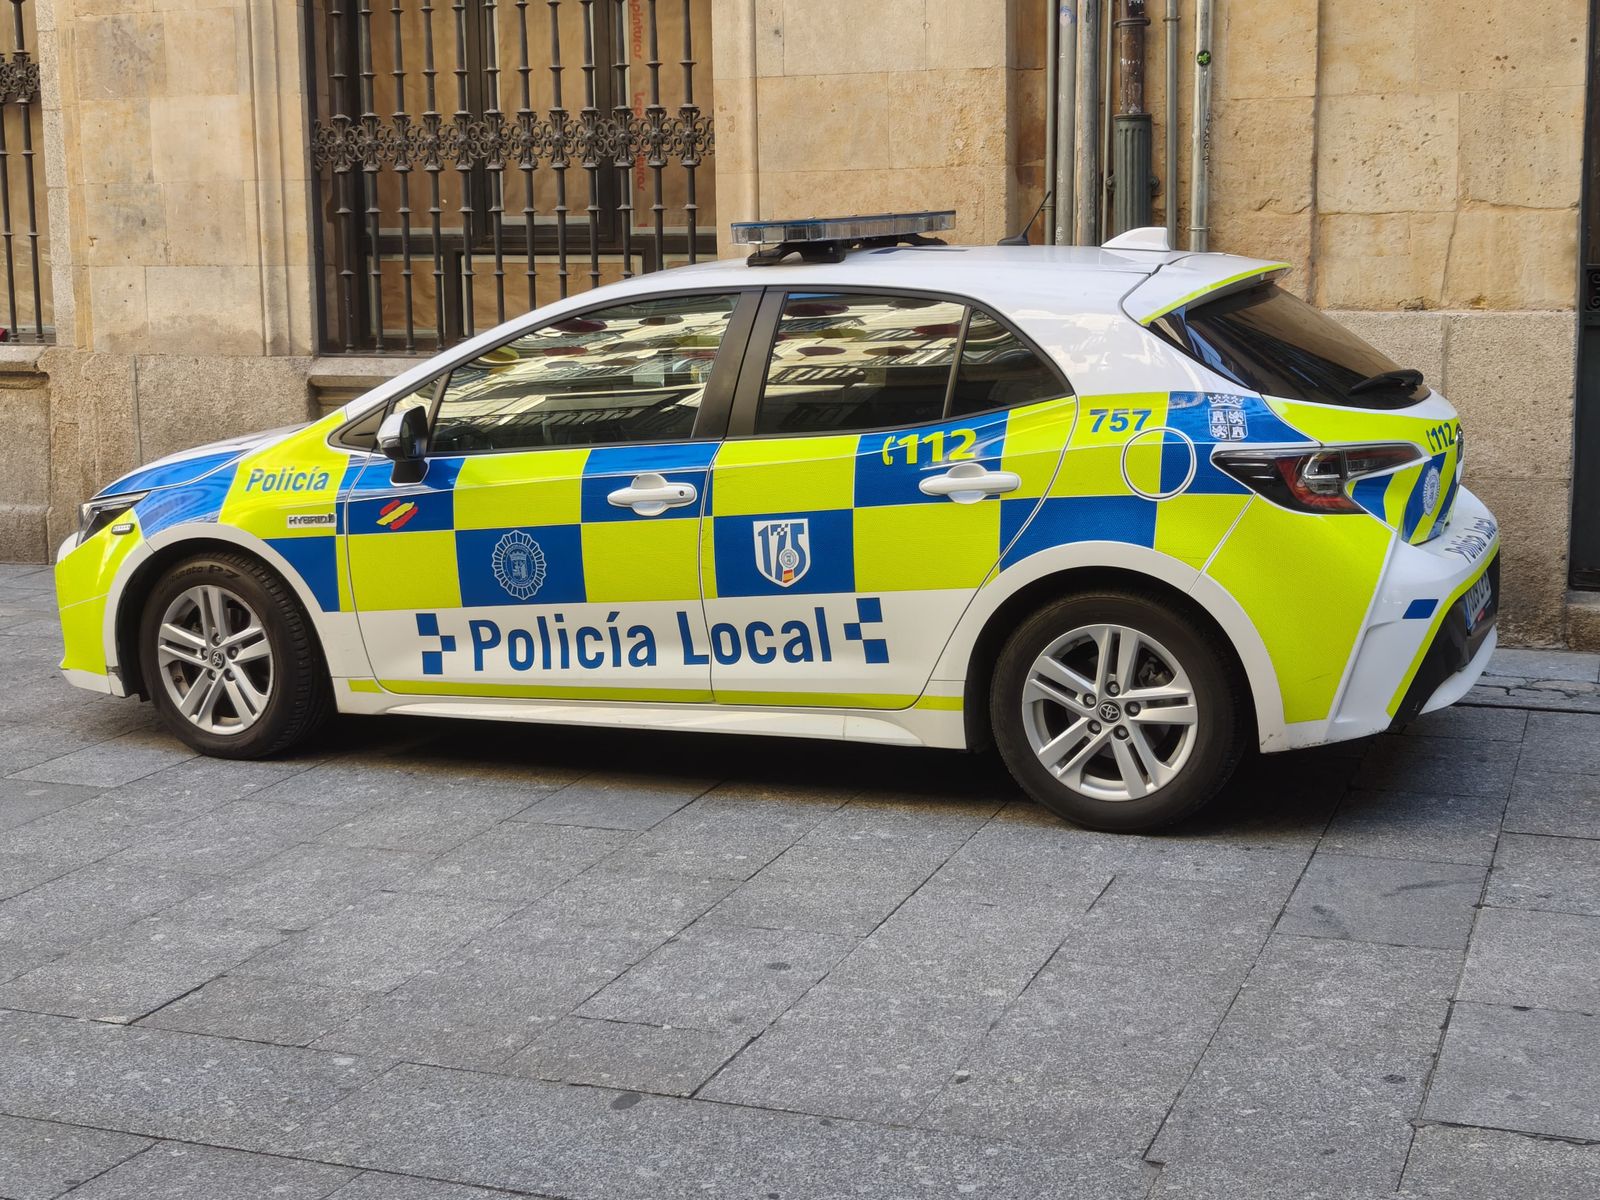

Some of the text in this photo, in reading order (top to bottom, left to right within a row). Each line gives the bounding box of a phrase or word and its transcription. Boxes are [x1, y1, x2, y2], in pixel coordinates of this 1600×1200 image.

[1089, 408, 1152, 433] 757
[896, 428, 977, 465] 112
[1431, 422, 1455, 450] 112
[245, 466, 329, 492] Policía
[468, 606, 832, 672] Policía Local
